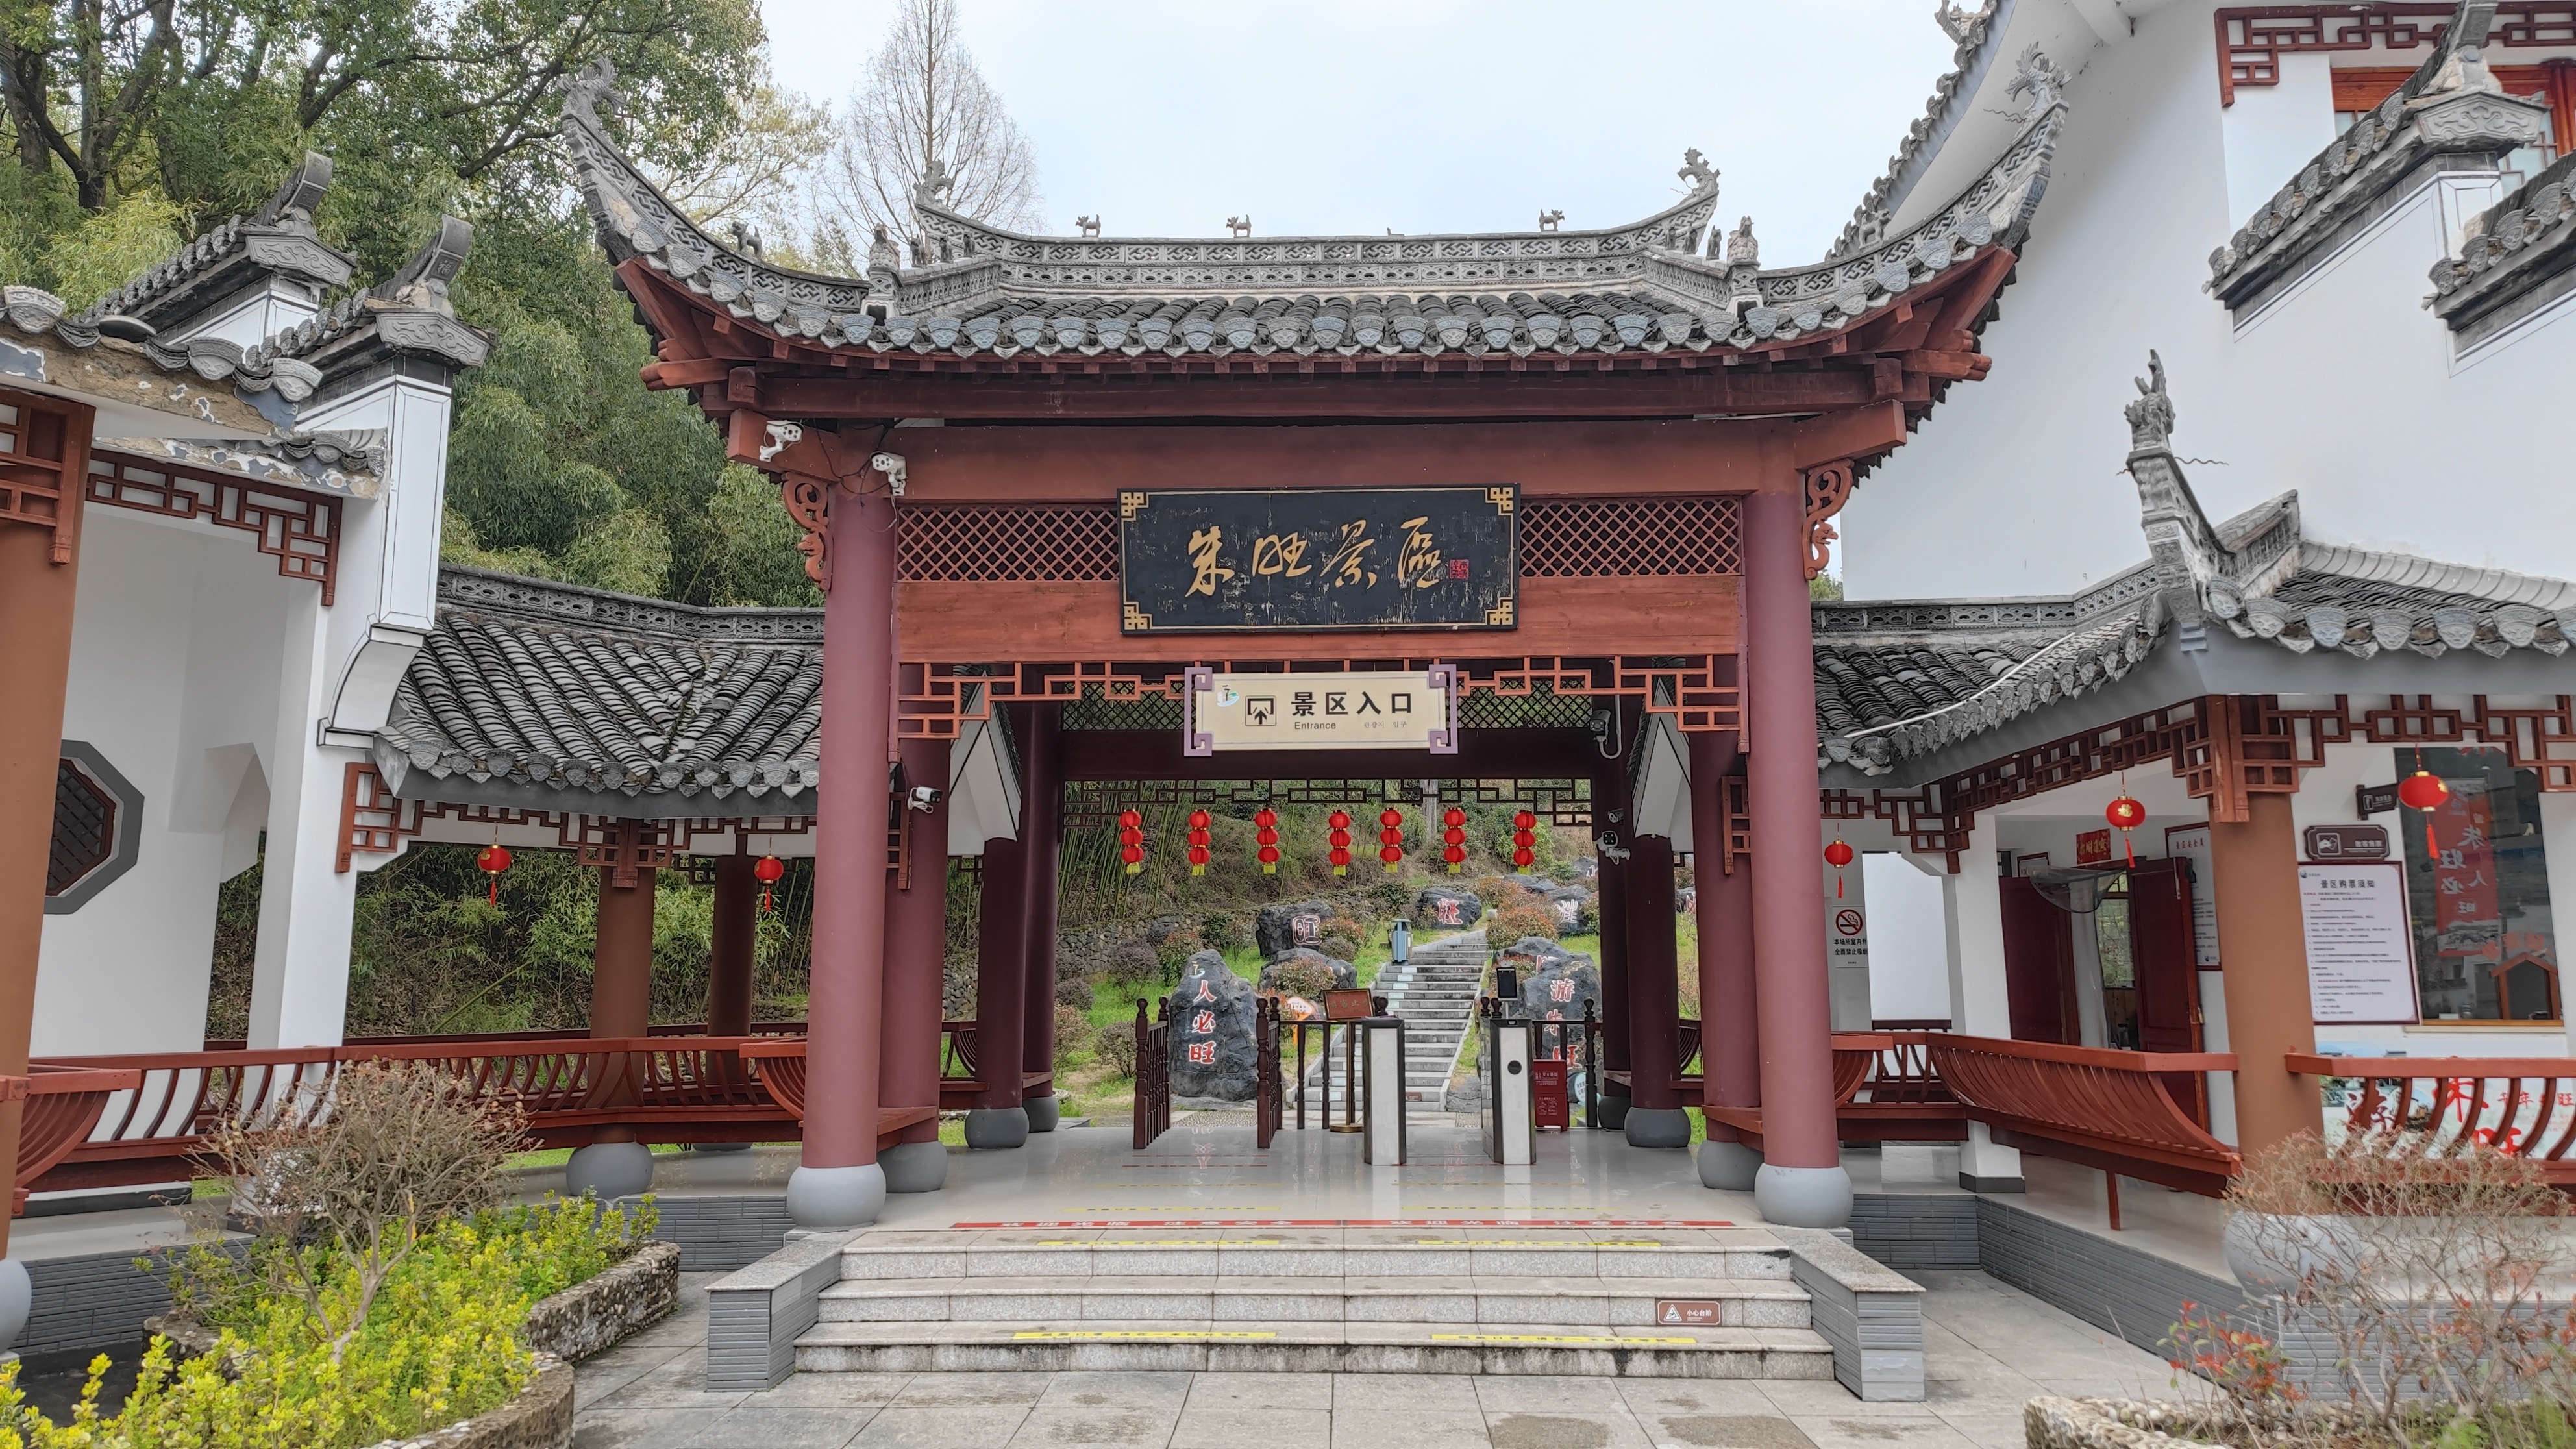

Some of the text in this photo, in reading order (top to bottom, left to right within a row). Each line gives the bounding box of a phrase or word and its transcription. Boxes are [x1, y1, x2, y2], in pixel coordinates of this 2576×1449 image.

[1291, 691, 1411, 715] 景区入口
[1294, 721, 1336, 730] Entrance
[2320, 879, 2375, 889] 景区购票须知
[1189, 979, 1217, 1065] 人必旺
